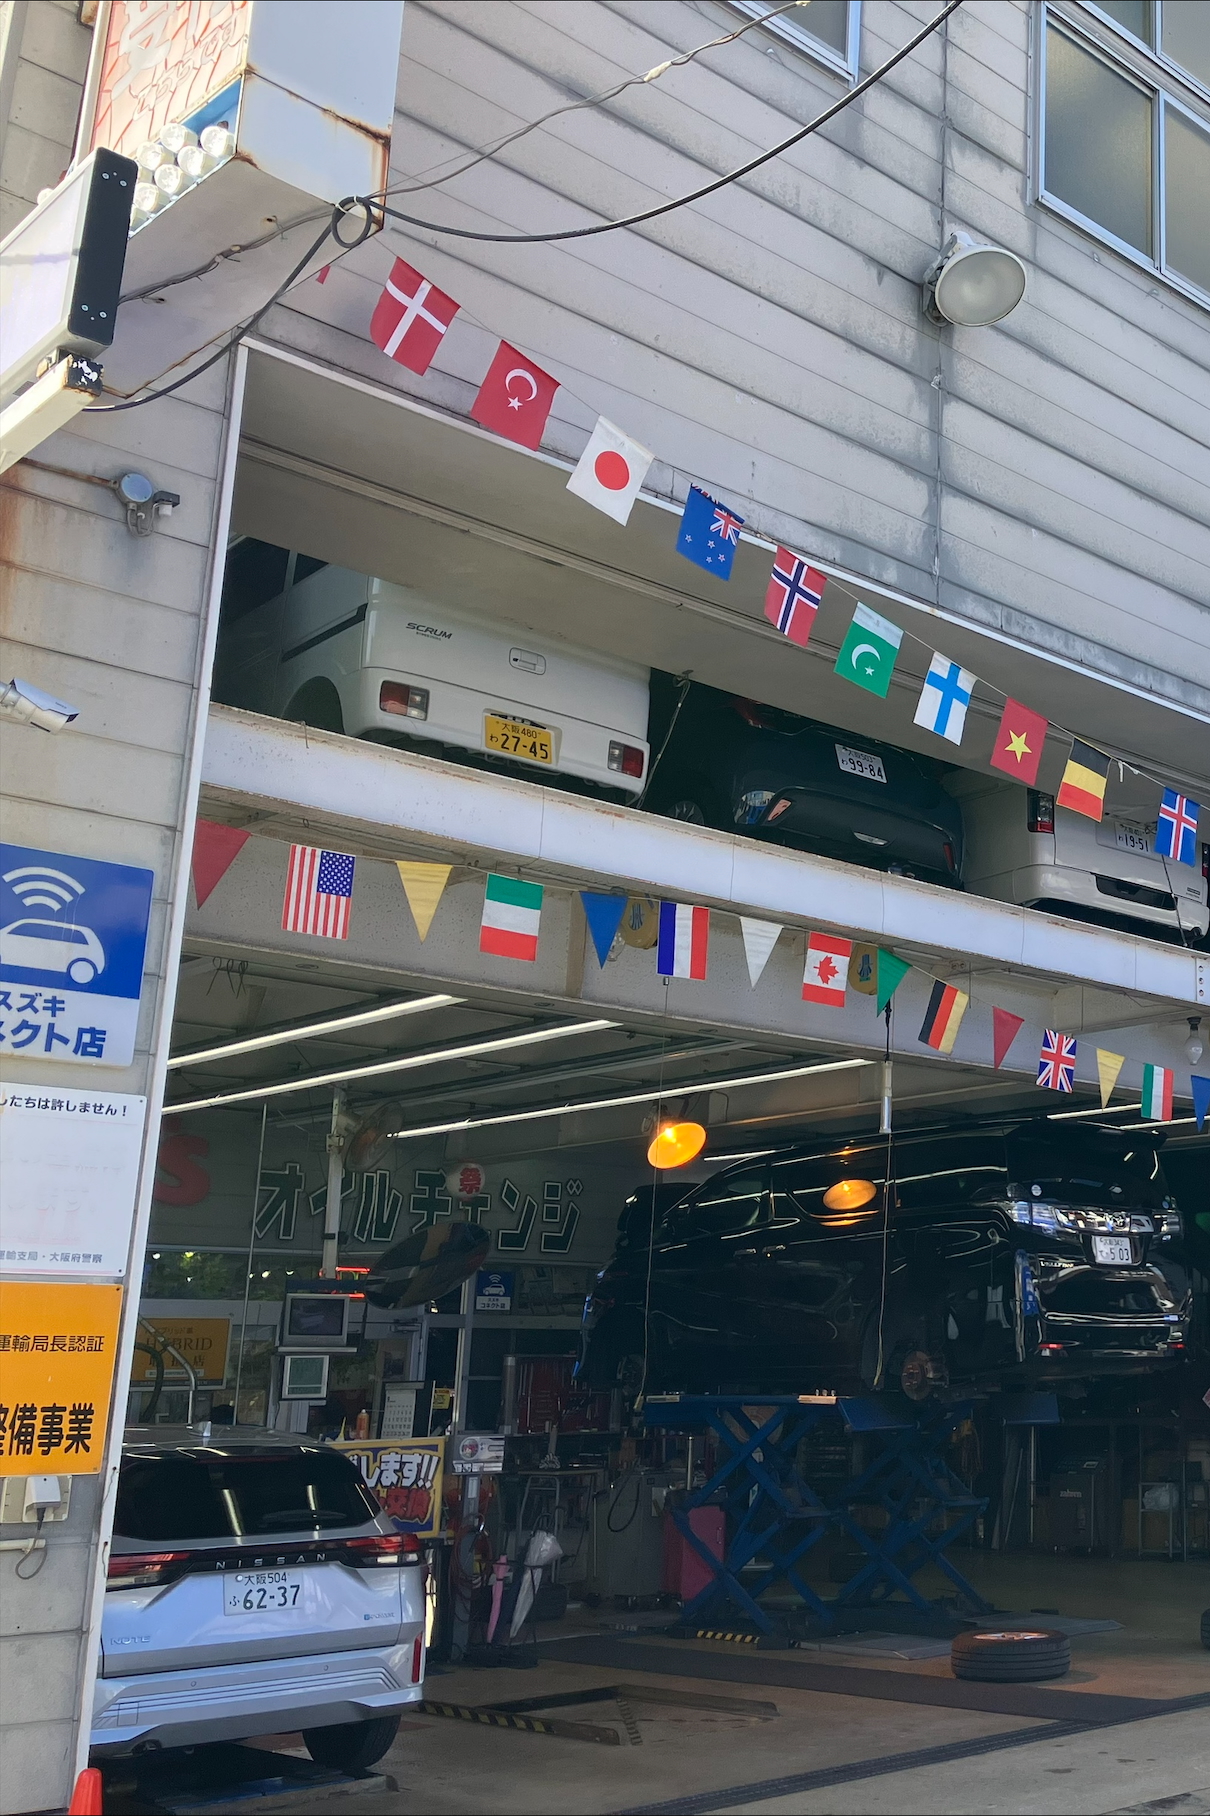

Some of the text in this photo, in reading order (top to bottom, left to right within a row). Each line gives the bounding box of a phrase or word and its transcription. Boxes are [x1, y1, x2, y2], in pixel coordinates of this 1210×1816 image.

[406, 622, 453, 640] SCRUM
[500, 733, 549, 760] 27-45
[848, 757, 884, 779] 99-84
[0, 990, 65, 1018] スズキ
[458, 1166, 482, 1194] 祭
[253, 1162, 581, 1253] オイルチェンジ
[146, 1337, 213, 1351] HBRID
[349, 1452, 440, 1489] します!!
[215, 1552, 327, 1570] NISSAN
[243, 1571, 288, 1587] 大阪504
[228, 1584, 300, 1611] ふ 62-37
[109, 1634, 151, 1646] NOTE
